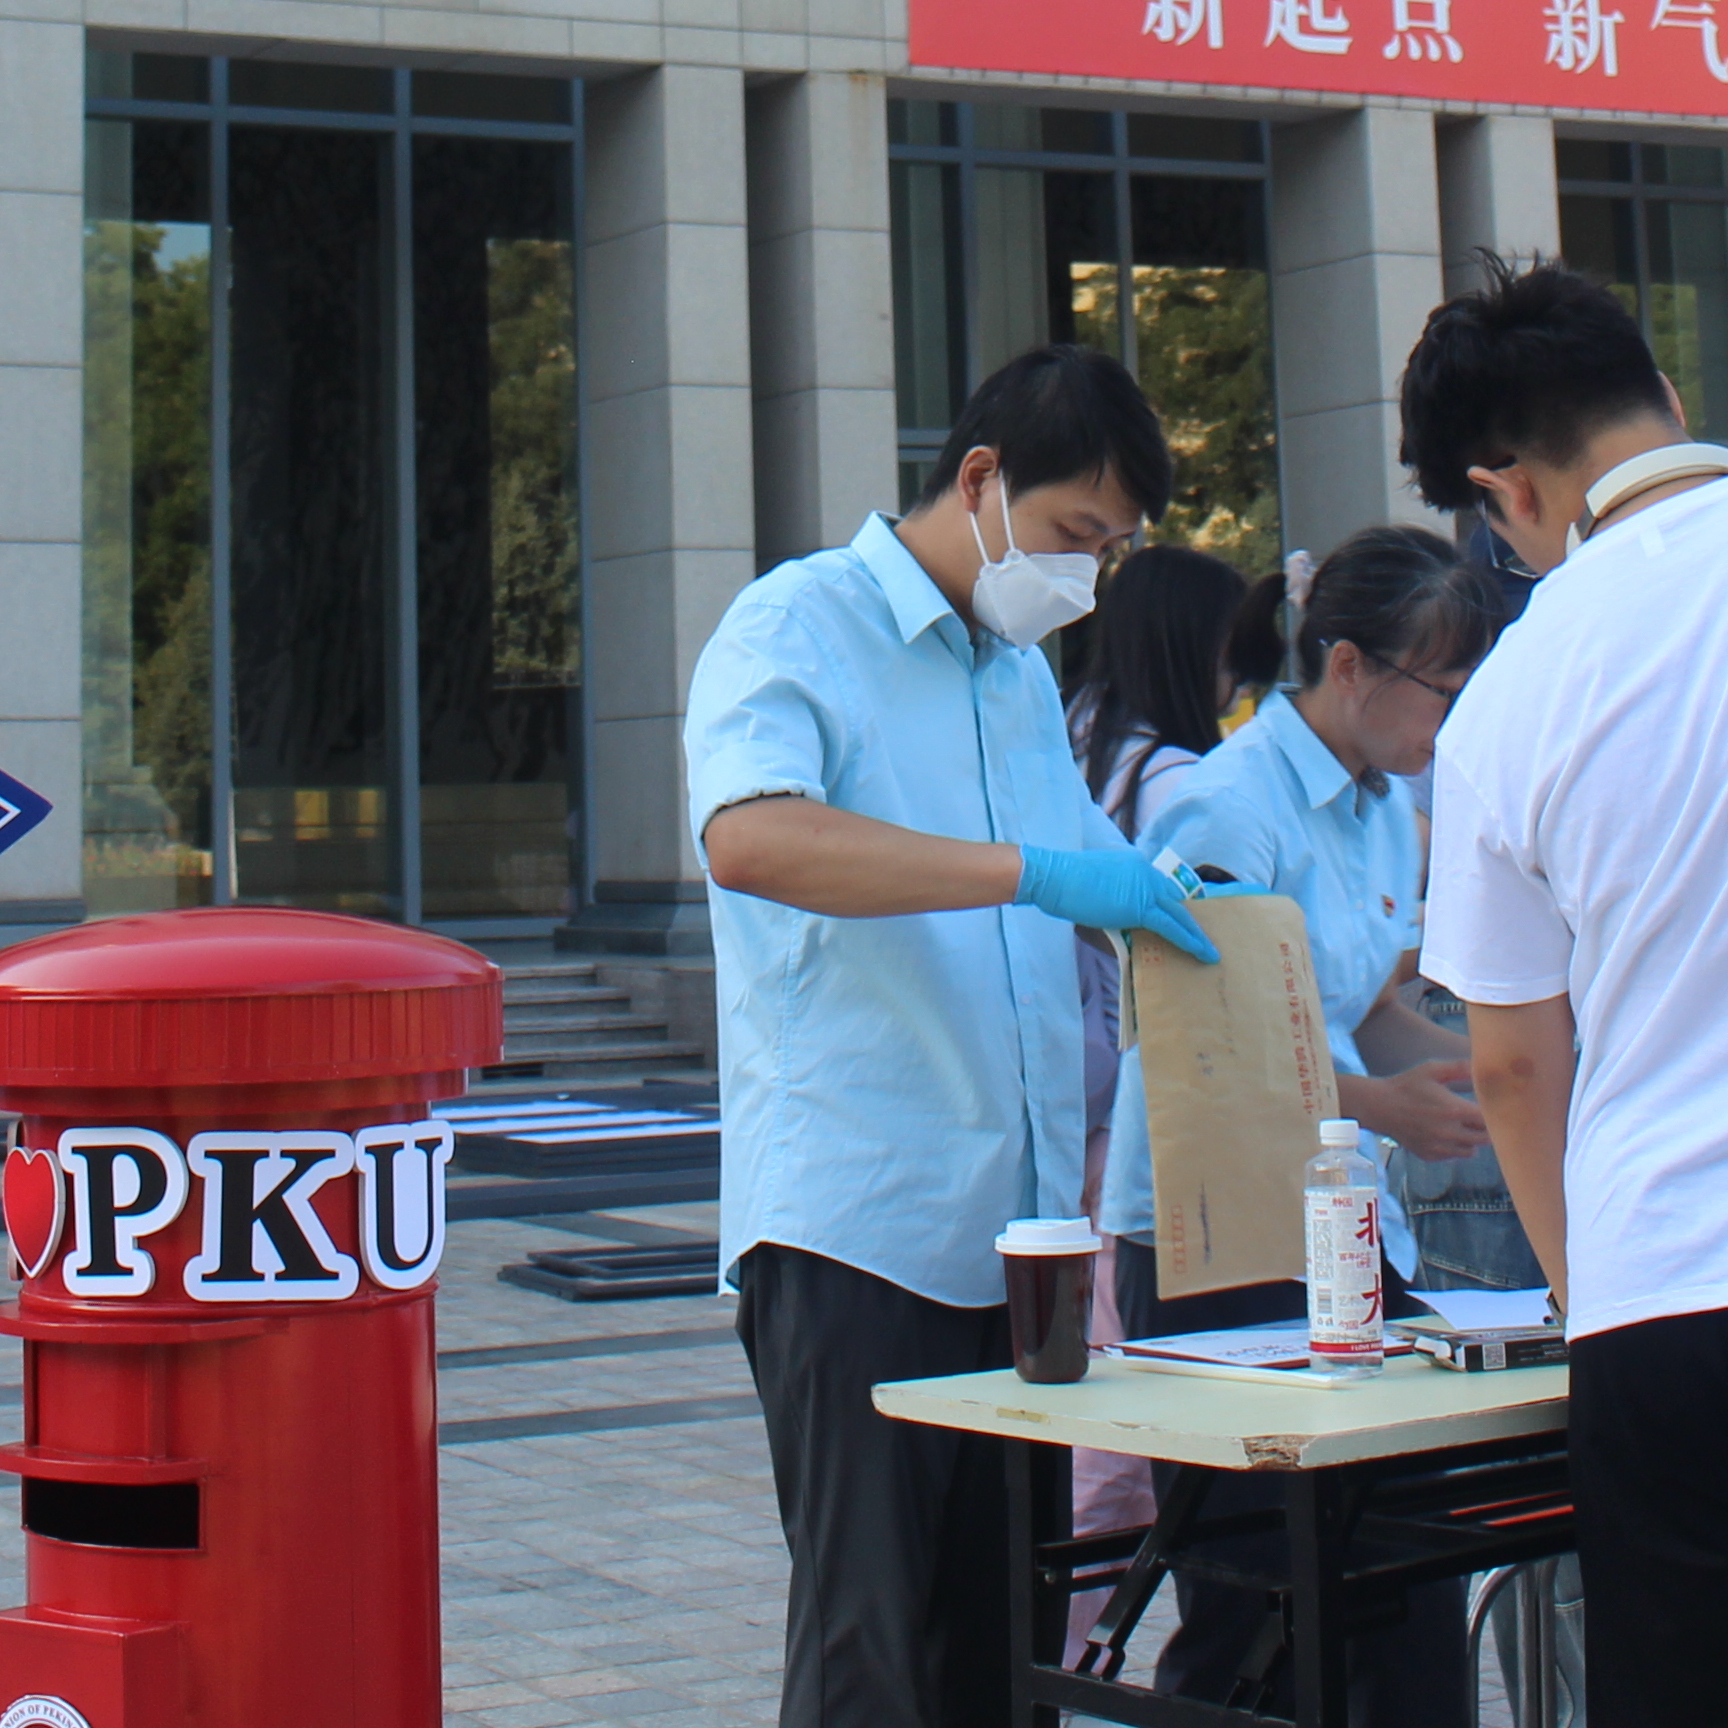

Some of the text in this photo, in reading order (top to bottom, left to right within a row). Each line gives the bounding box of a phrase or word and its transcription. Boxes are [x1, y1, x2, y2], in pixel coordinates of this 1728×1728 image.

[69, 1134, 447, 1285] PKU
[27, 1704, 42, 1715] OF
[43, 1704, 75, 1728] PEKIN
